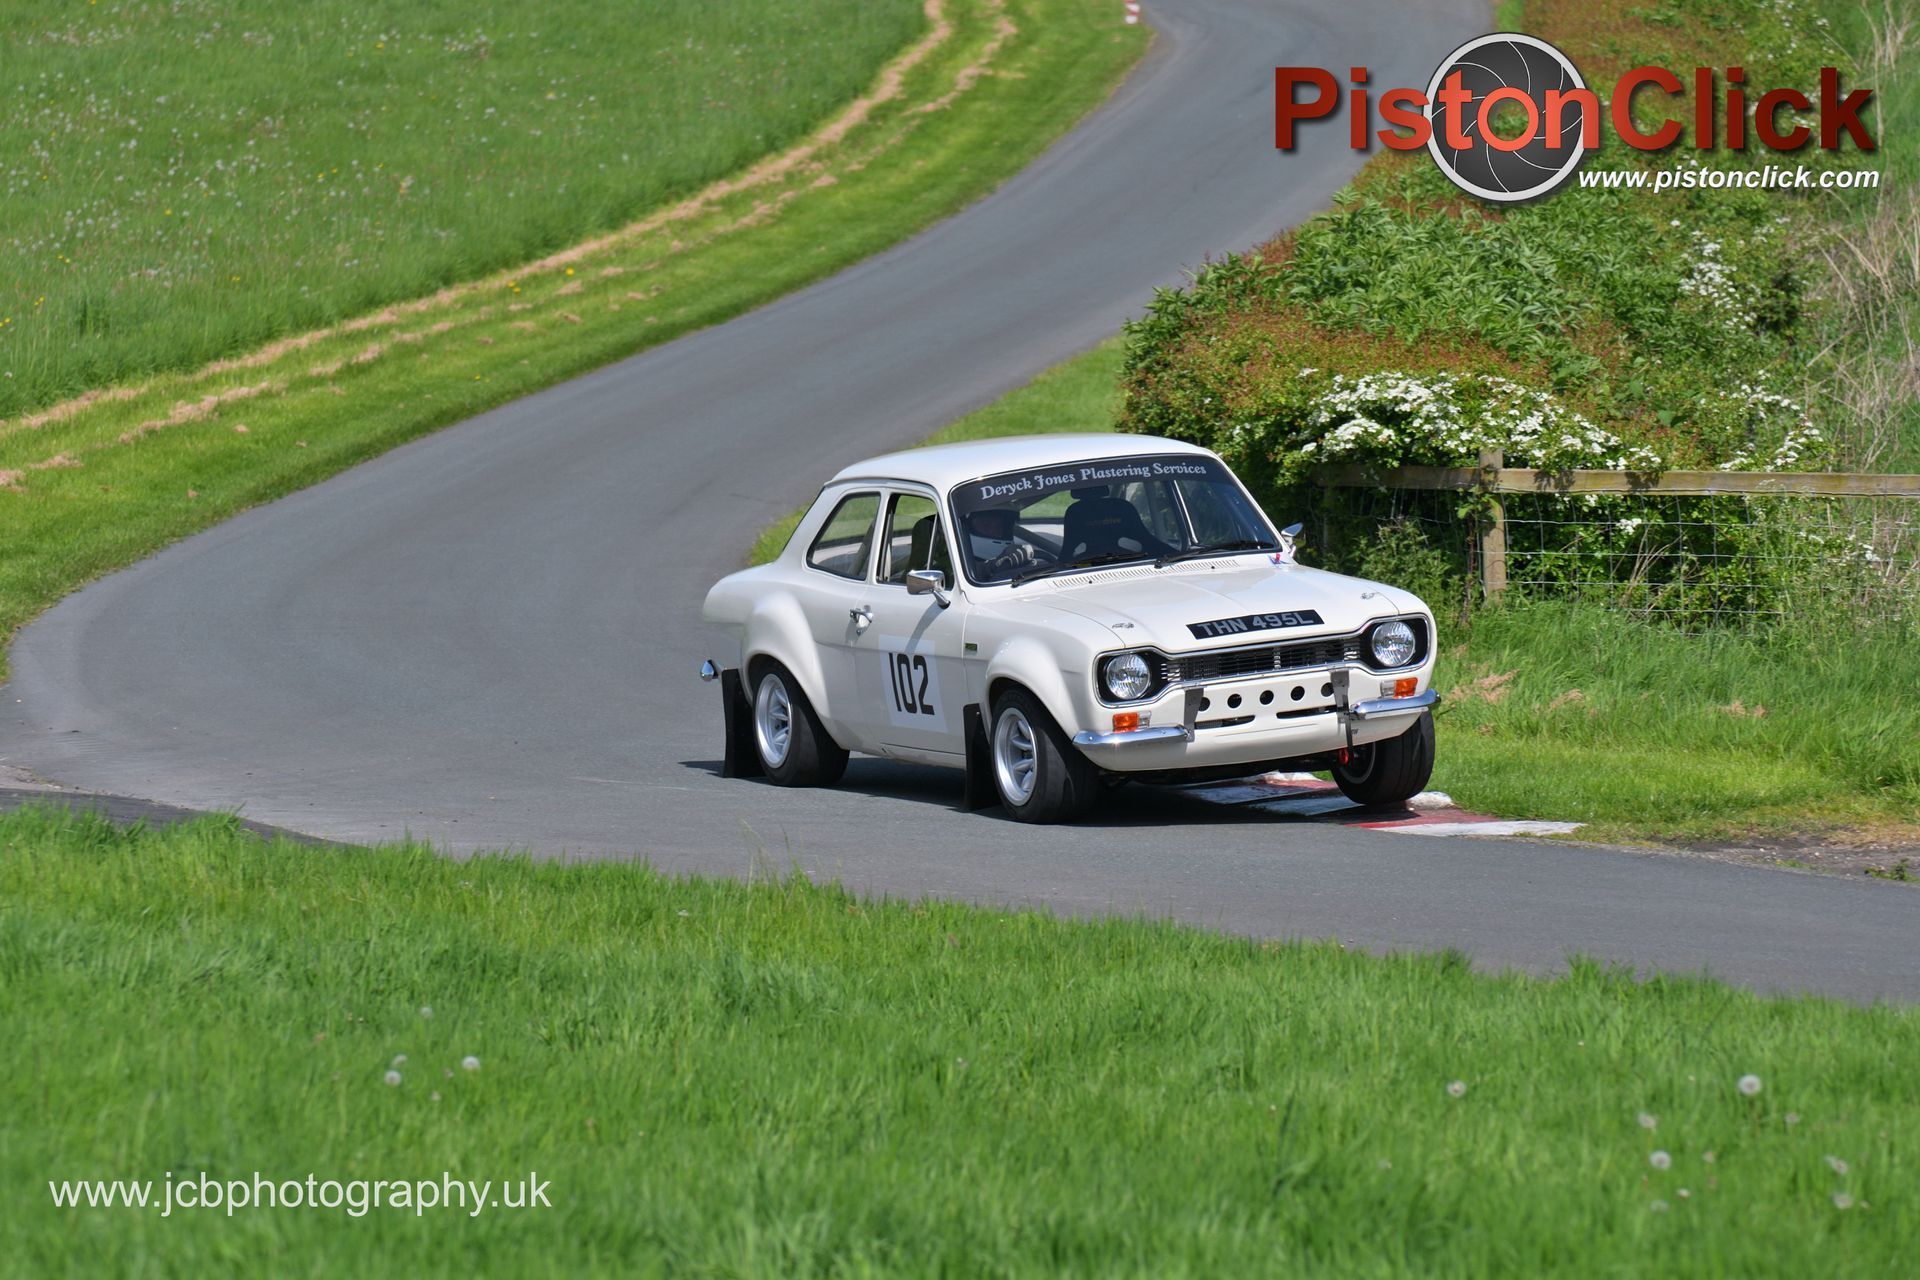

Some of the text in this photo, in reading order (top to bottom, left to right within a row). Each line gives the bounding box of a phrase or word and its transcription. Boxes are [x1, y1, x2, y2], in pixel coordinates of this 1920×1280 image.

[980, 462, 1207, 500] Deryck Jones Plastering Services
[1197, 612, 1314, 636] THN 495L
[888, 652, 935, 716] 102
